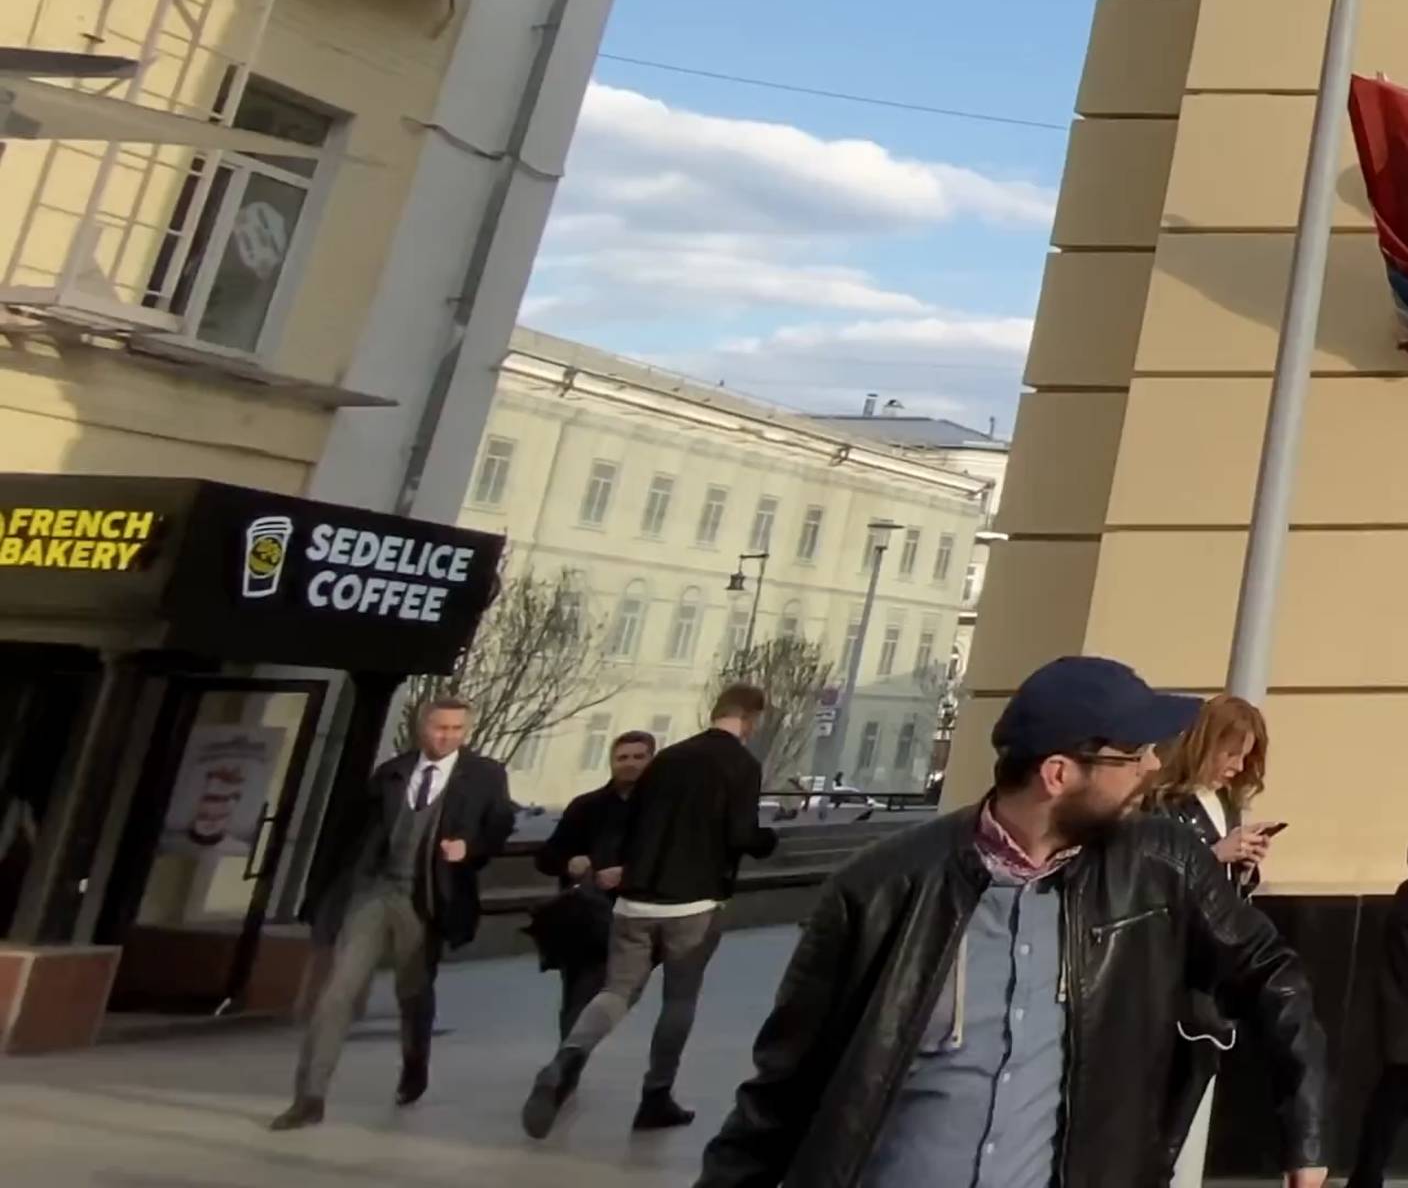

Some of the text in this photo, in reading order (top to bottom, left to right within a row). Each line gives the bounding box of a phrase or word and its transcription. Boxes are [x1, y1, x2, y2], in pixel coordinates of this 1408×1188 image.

[8, 508, 155, 539] FRENCH
[0, 537, 142, 571] BAKERY
[305, 523, 475, 582] SEDELICE
[307, 570, 449, 622] COFFEE
